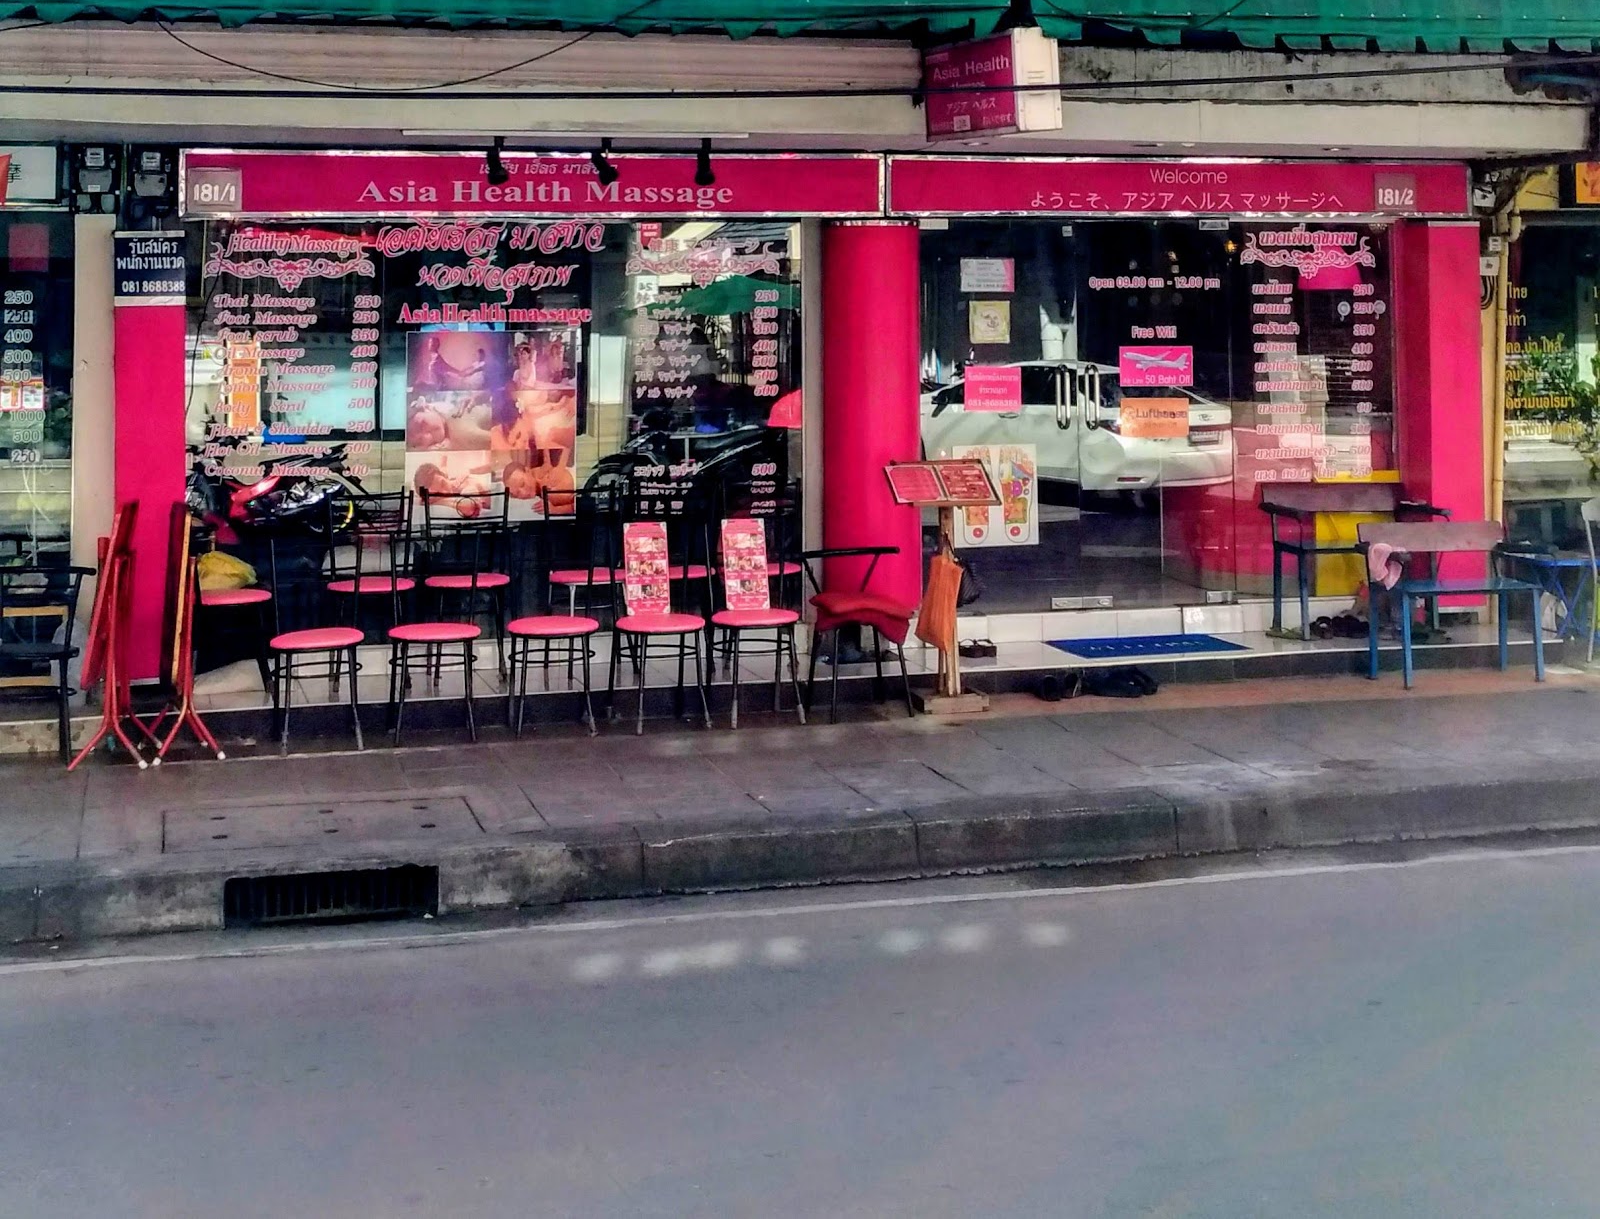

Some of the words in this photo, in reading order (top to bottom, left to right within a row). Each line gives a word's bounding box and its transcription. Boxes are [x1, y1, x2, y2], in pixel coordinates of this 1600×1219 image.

[933, 66, 961, 81] Asia
[965, 55, 1010, 75] Health
[1149, 168, 1228, 185] Welcome
[193, 183, 236, 202] 181/1
[356, 180, 438, 203] Asia
[451, 180, 571, 203] Health
[586, 180, 734, 209] Massage
[1378, 187, 1414, 206] 181/2
[128, 238, 179, 255] รับสมัคร
[224, 233, 291, 257] Healthy
[289, 235, 359, 257] Massage
[116, 254, 185, 270] พนักงานนวด
[122, 281, 140, 293] 081
[1089, 276, 1115, 291] Open
[1148, 277, 1165, 288] am
[1204, 277, 1221, 290] pm
[1507, 282, 1528, 299] ไทย
[4, 290, 33, 305] 250
[213, 293, 249, 308] Thai
[251, 294, 316, 311] Massage
[354, 295, 382, 309] 250
[755, 290, 779, 302] 250
[4, 309, 34, 324] 250
[214, 311, 250, 325] Foot
[252, 311, 318, 328] Massage
[352, 311, 380, 324] 250
[396, 302, 442, 323] Asia
[441, 302, 507, 323] Health
[508, 308, 593, 327] massage
[754, 307, 779, 319] 250
[1507, 309, 1527, 327] เท้า
[3, 329, 33, 343] 400
[217, 327, 251, 342] Foot
[254, 327, 299, 342] scrub
[351, 329, 379, 342] 350
[753, 322, 779, 335] 350
[1131, 326, 1154, 339] Free
[214, 347, 236, 359] Oil
[244, 346, 306, 362] Massage
[351, 345, 378, 357] 400
[752, 340, 778, 352] 400
[3, 349, 33, 364] 500
[752, 356, 778, 368] 500
[3, 369, 32, 383] 500
[211, 362, 268, 380] Aroma
[274, 363, 336, 379] Massage
[351, 362, 378, 375] 500
[753, 370, 778, 382] 500
[265, 380, 329, 395] Massage
[351, 377, 378, 389] 500
[1145, 375, 1156, 384] 50
[754, 385, 779, 397] 500
[214, 400, 251, 417] Body
[348, 398, 374, 409] 500
[10, 409, 46, 423] 1000
[269, 422, 334, 436] Shoulder
[345, 420, 373, 432] 250
[13, 430, 42, 443] 500
[236, 442, 261, 455] Oil
[204, 465, 265, 477] Coconut
[751, 463, 777, 476] 500
